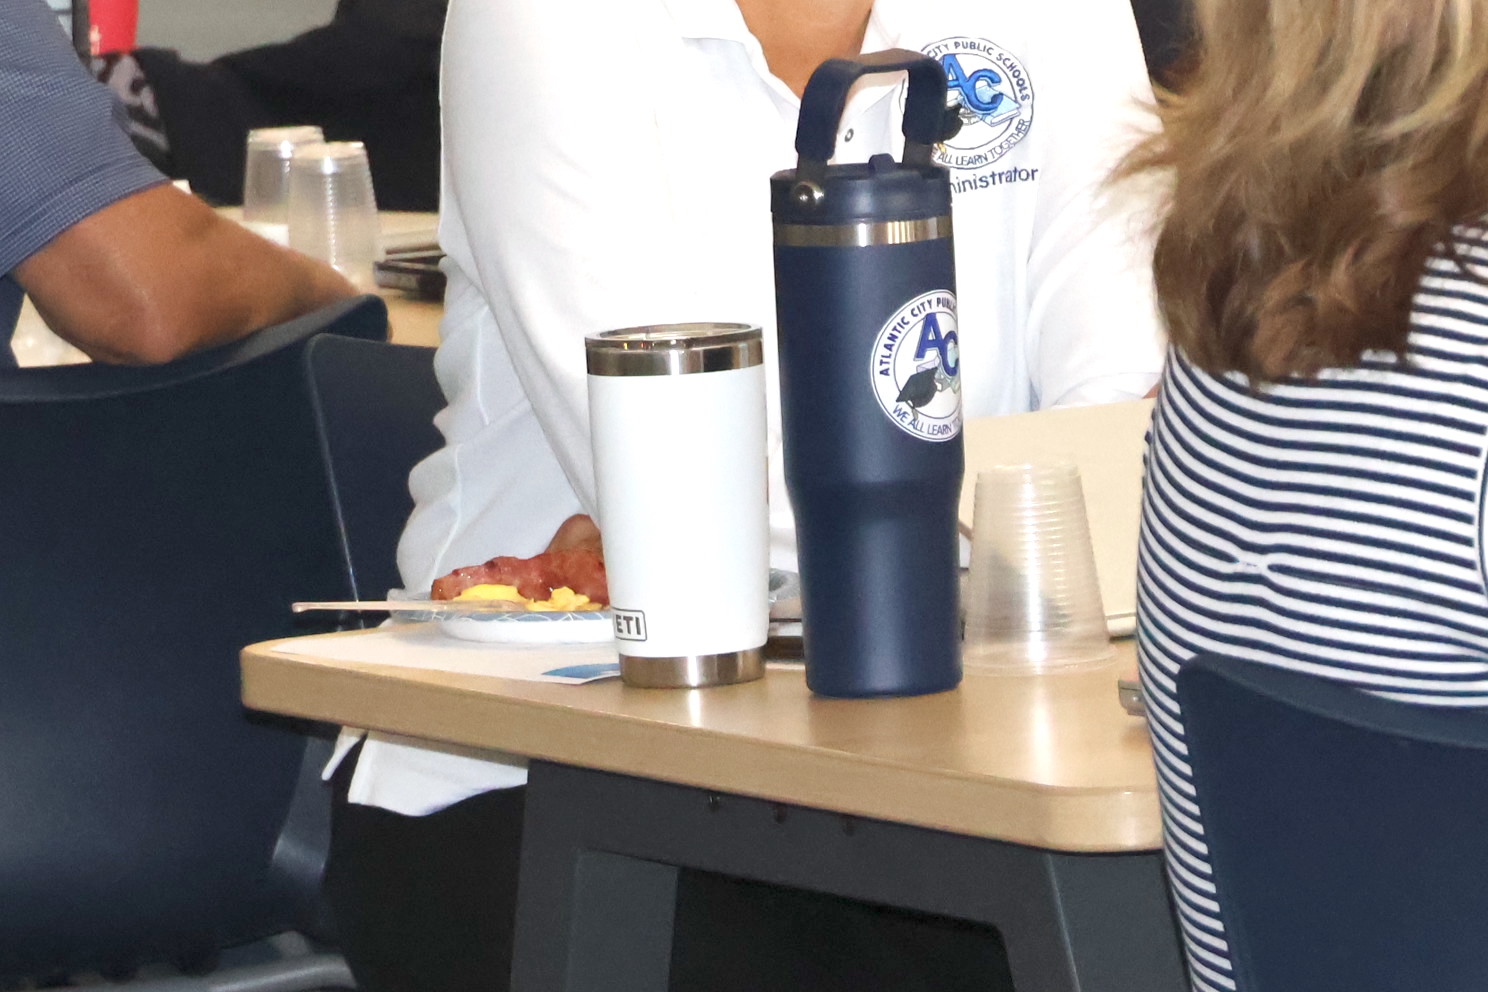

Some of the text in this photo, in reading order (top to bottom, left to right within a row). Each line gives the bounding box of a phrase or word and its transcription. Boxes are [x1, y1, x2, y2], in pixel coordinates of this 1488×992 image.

[954, 41, 994, 56] PUBLIC
[996, 52, 1030, 102] SCHOOLS
[956, 152, 988, 167] LEARN
[989, 118, 1030, 159] TOGETHER
[879, 316, 910, 377] ATLANTIC
[911, 298, 933, 317] CITY
[893, 404, 910, 423] WE
[908, 418, 925, 433] ALL
[927, 423, 952, 436] LEARN
[616, 614, 641, 636] ETI
